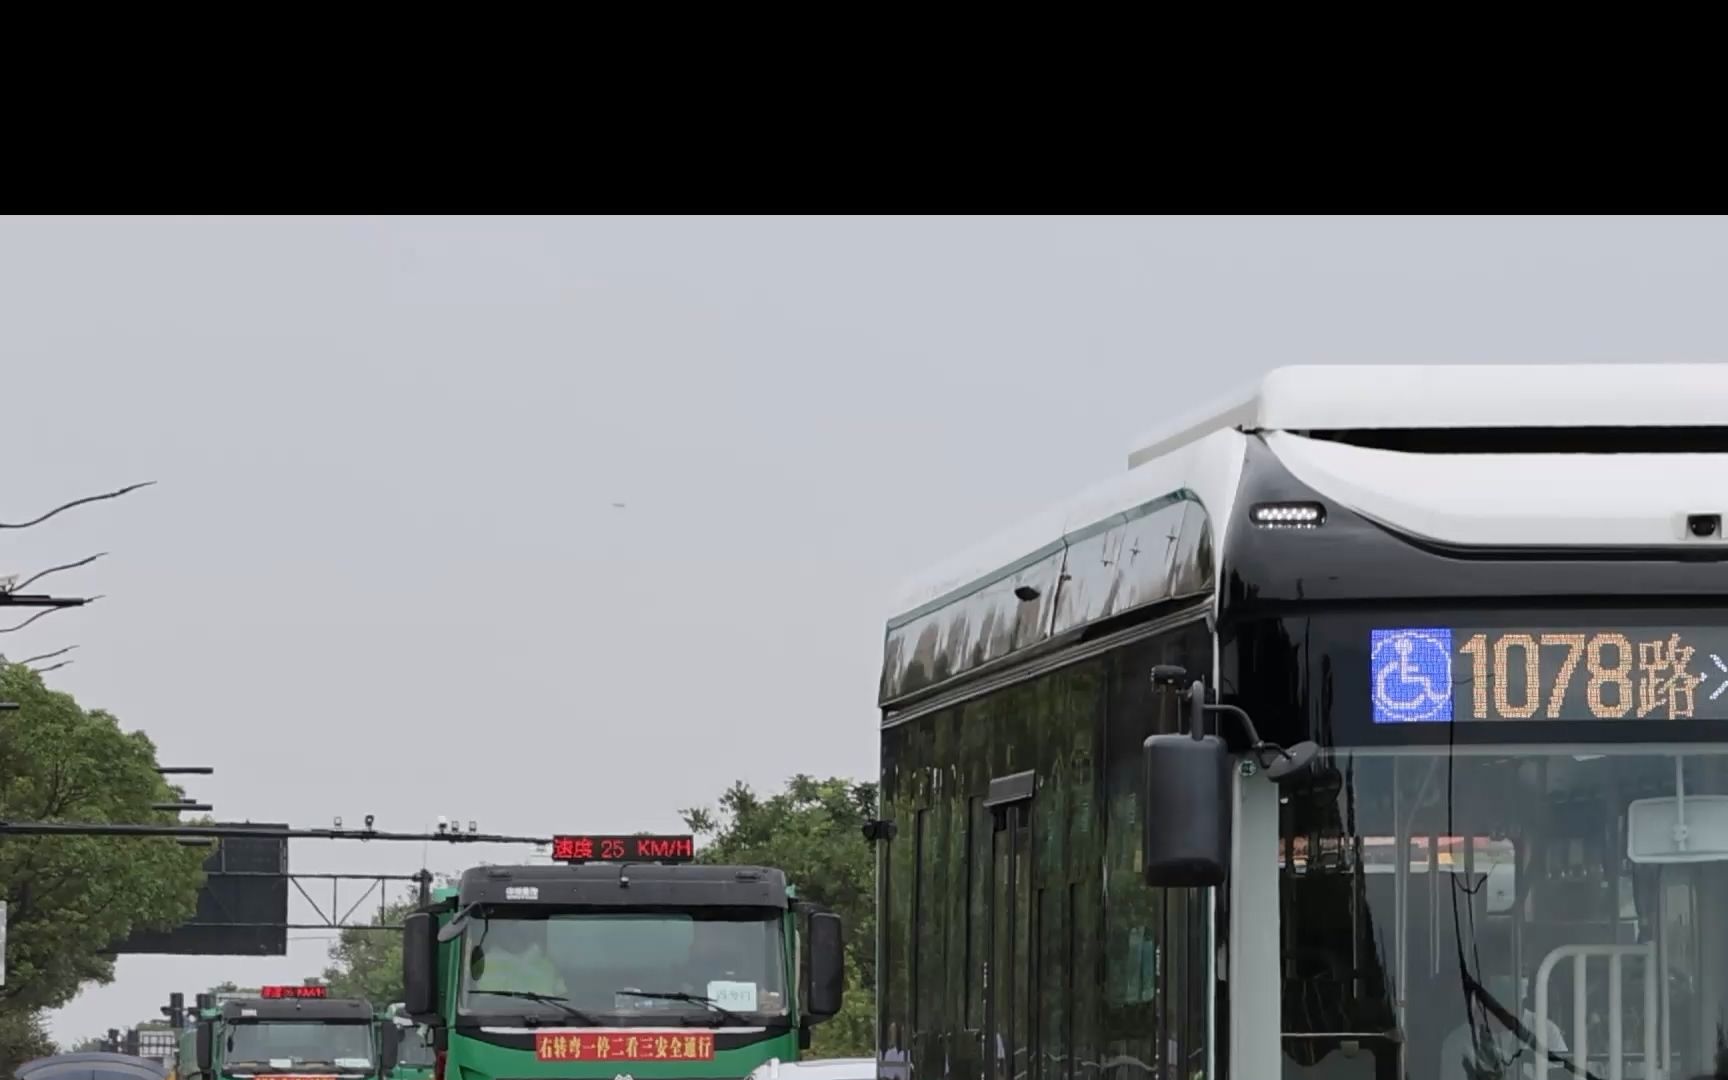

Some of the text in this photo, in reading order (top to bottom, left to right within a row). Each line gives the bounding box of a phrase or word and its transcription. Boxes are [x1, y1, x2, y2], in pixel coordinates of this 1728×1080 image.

[555, 838, 691, 859] 速度 25 KM/H
